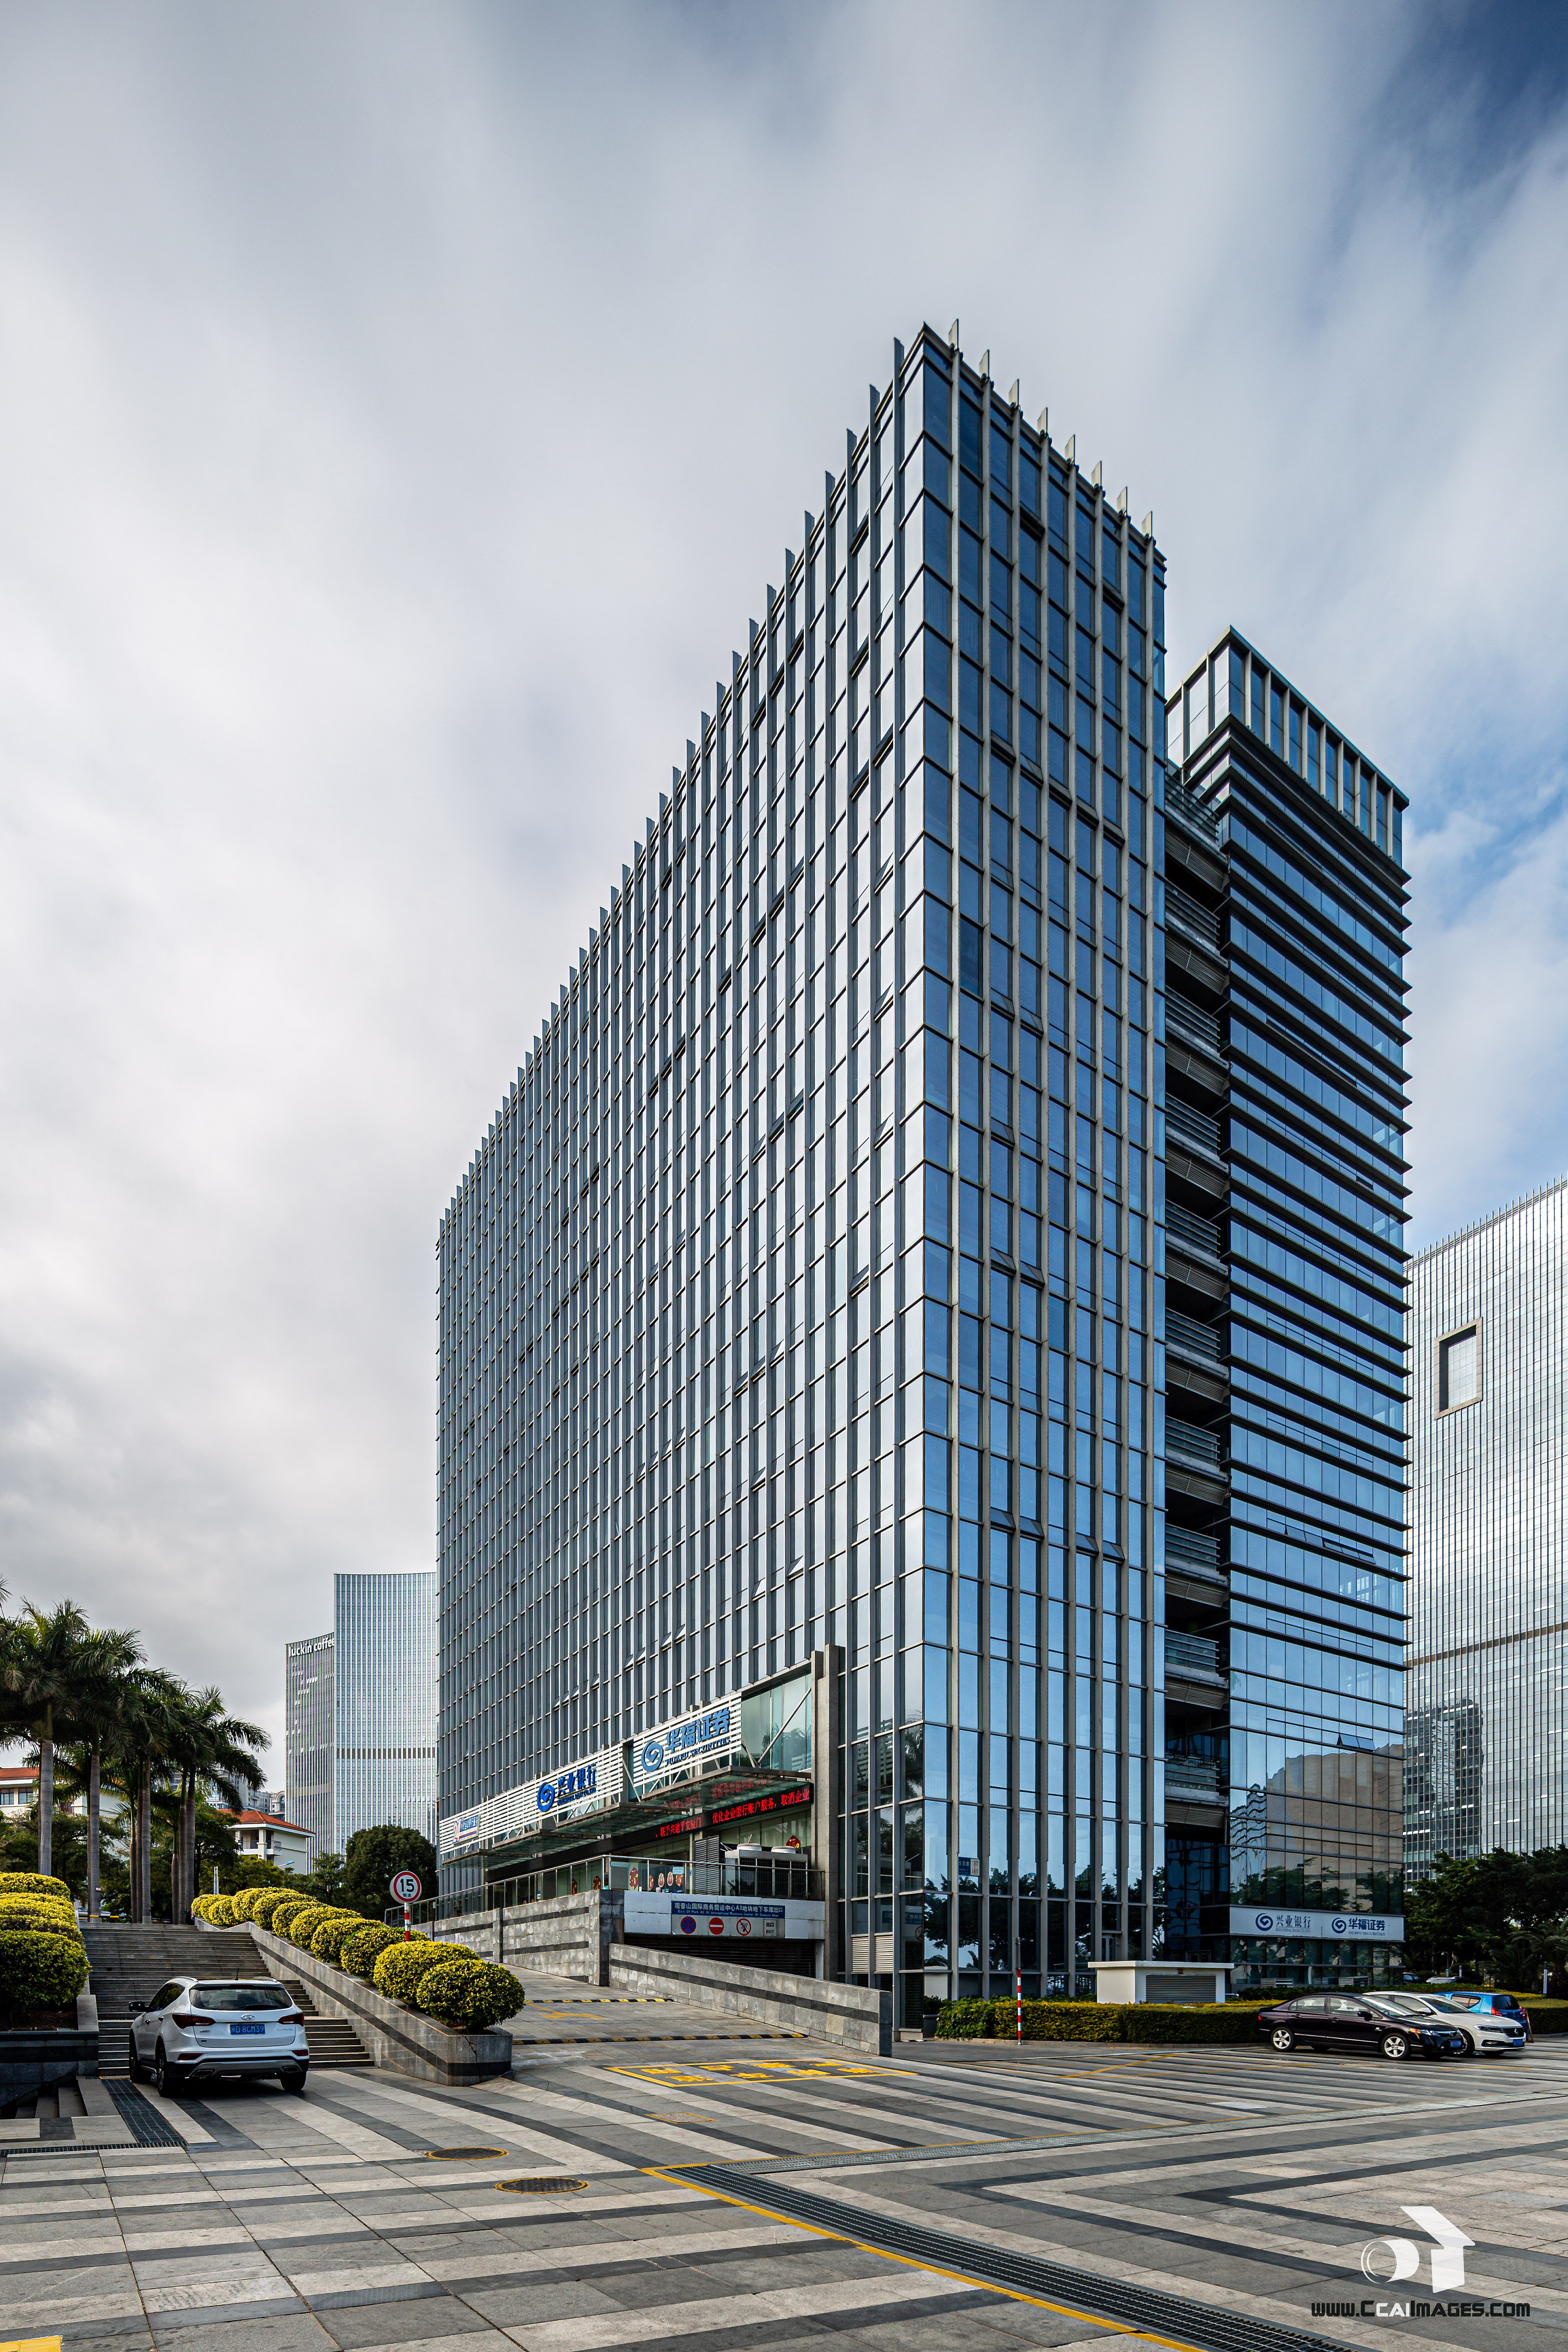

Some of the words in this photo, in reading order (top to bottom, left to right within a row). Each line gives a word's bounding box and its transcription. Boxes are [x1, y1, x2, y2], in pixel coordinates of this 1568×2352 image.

[289, 1642, 312, 1657] luckin
[314, 1637, 335, 1652] coffee
[665, 1708, 730, 1753] 华福证券
[666, 1753, 689, 1765] HUAFU
[690, 1737, 731, 1756] SECURITIES
[557, 1763, 597, 1797] 兴业银行
[400, 1878, 415, 1893] 15
[1275, 1915, 1311, 1929] 兴业银行
[1348, 1918, 1385, 1931] 华福证券
